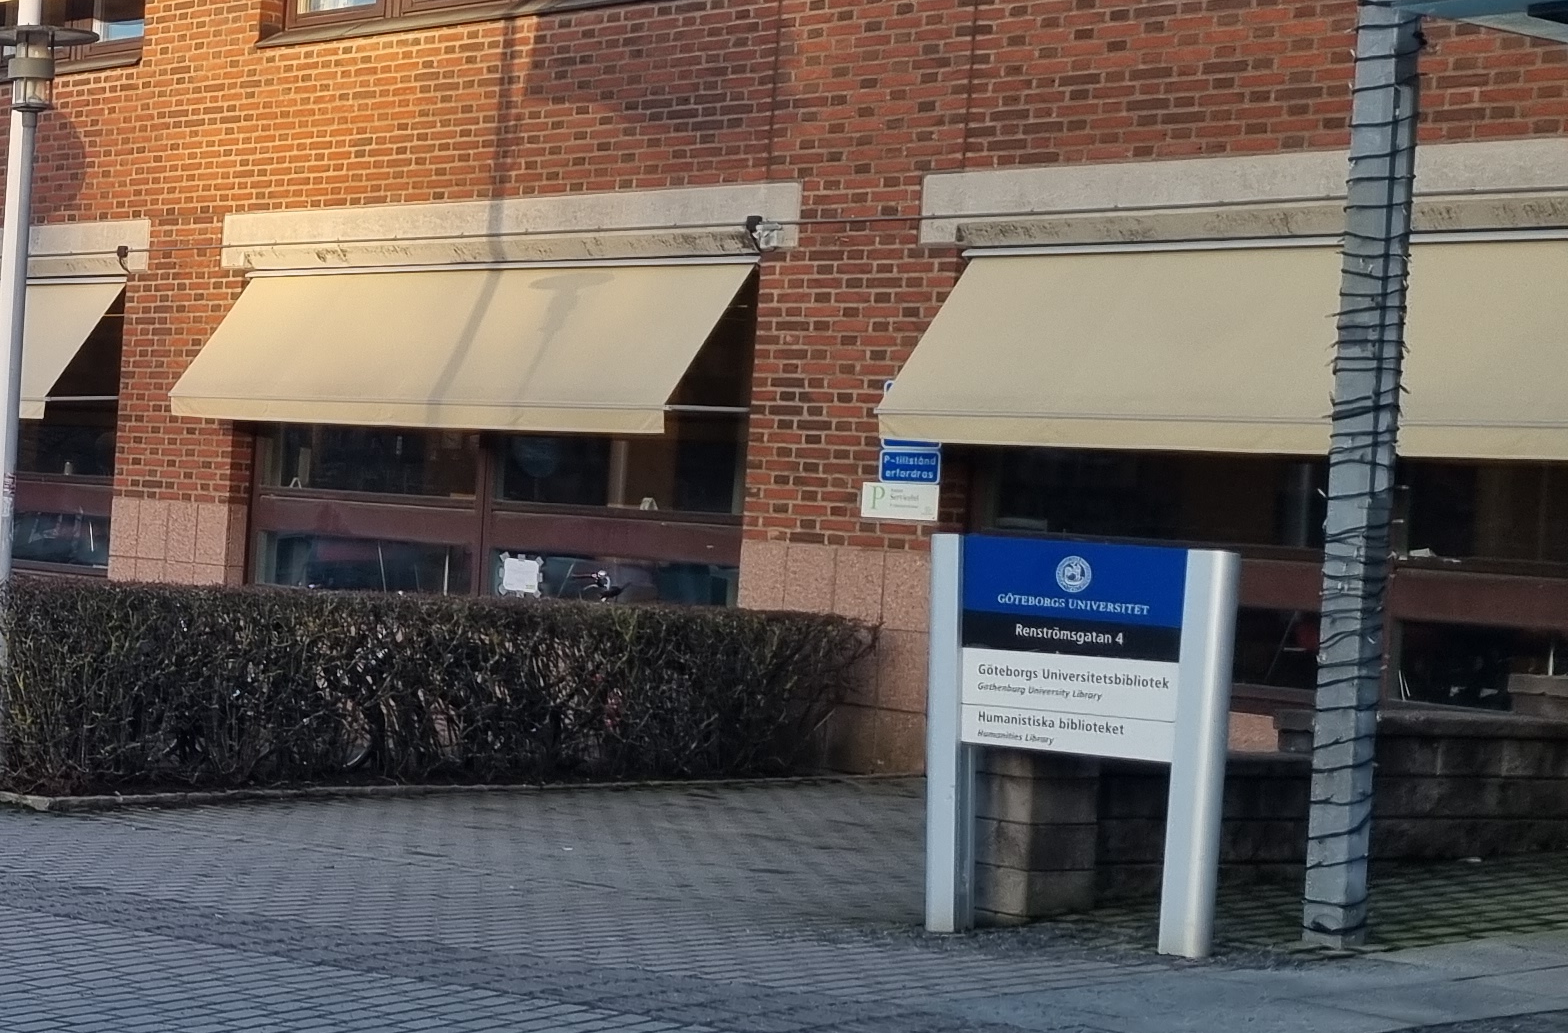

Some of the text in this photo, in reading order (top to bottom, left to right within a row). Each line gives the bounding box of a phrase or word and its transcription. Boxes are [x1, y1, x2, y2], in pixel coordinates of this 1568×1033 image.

[884, 455, 936, 465] P-tillstånd
[885, 468, 934, 479] erfordras
[871, 485, 885, 509] P
[997, 592, 1150, 615] GÖTEBORGS UNIVERSITET
[1015, 623, 1124, 645] Renströmsgatan 4
[978, 664, 1170, 688] Göteborgs Universitetsbibliotek
[977, 682, 1102, 701] Gothenburg University Library
[978, 711, 1125, 735] Humanistiska biblioteket
